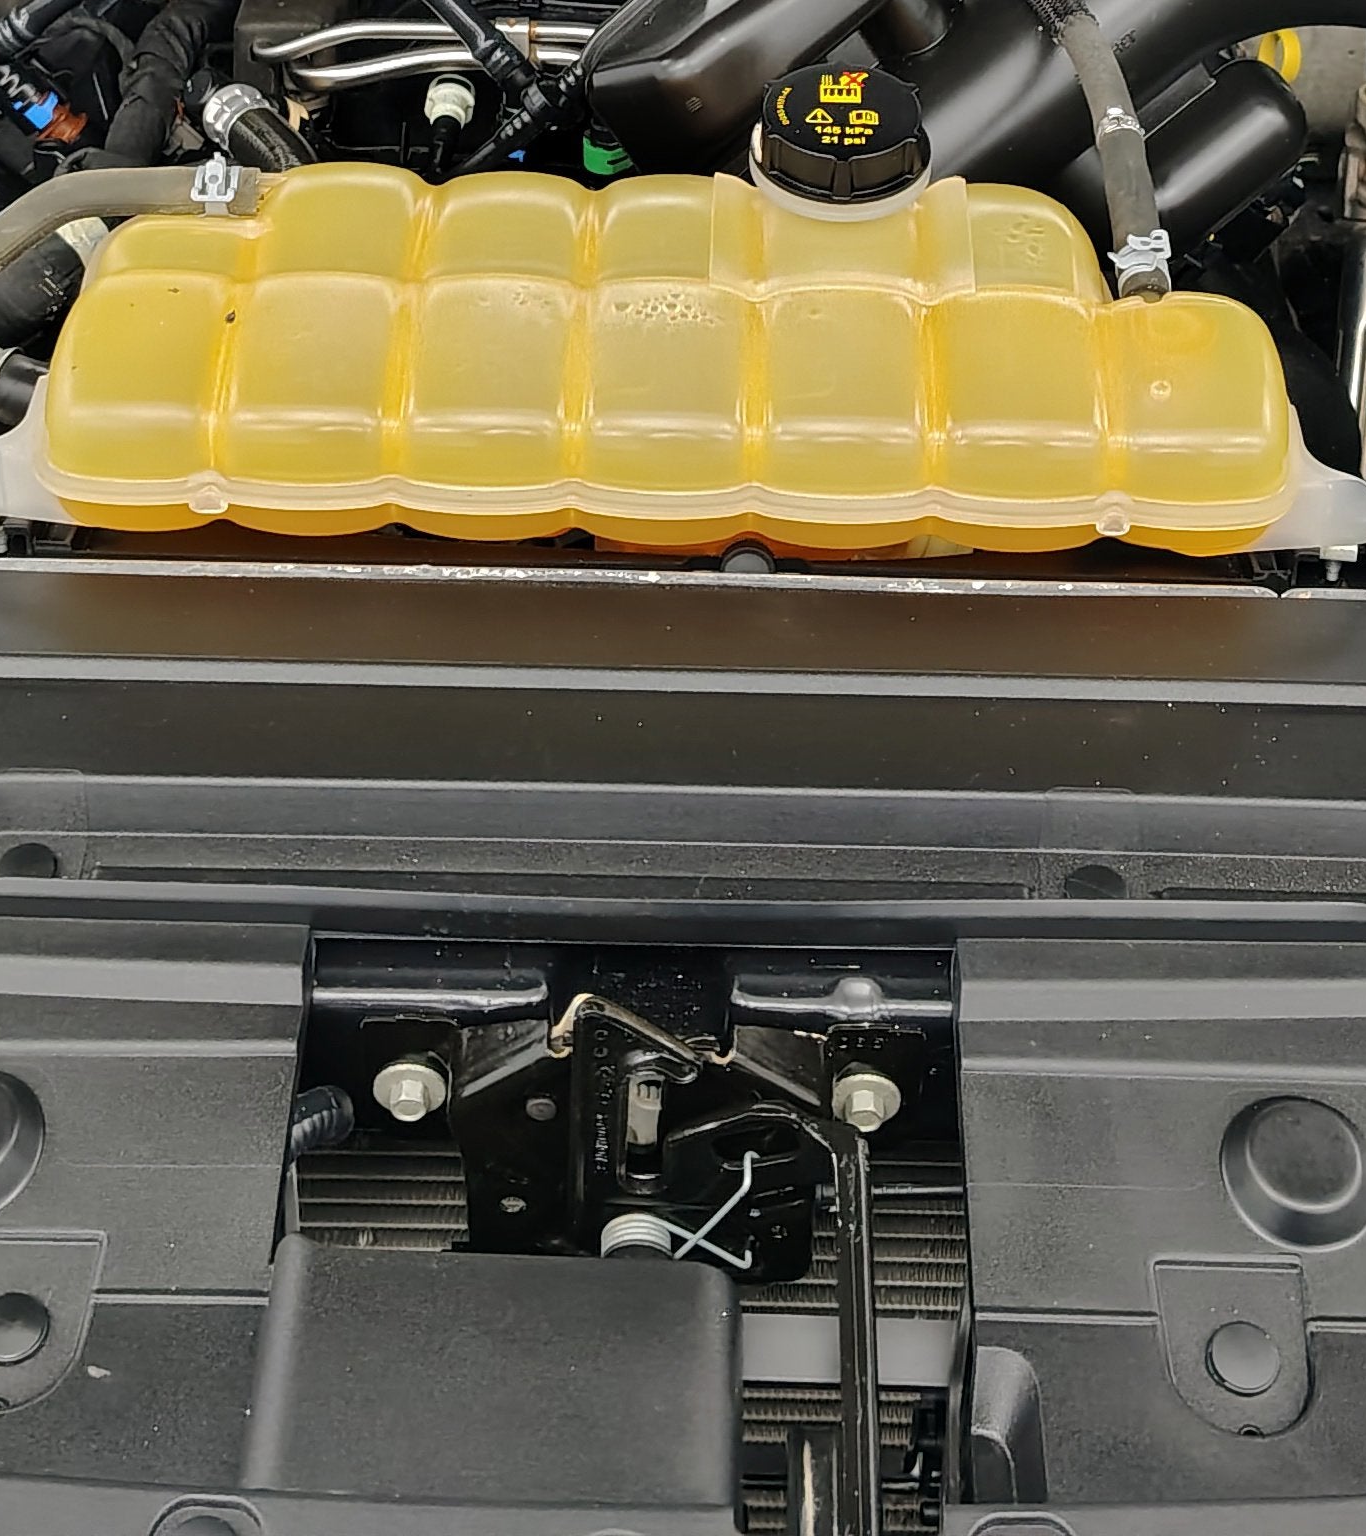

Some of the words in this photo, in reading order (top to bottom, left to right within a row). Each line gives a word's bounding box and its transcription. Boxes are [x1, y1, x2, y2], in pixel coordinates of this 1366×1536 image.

[814, 126, 842, 135] 145
[845, 126, 874, 135] kPa
[821, 136, 839, 144] 21
[843, 135, 866, 146] psi
